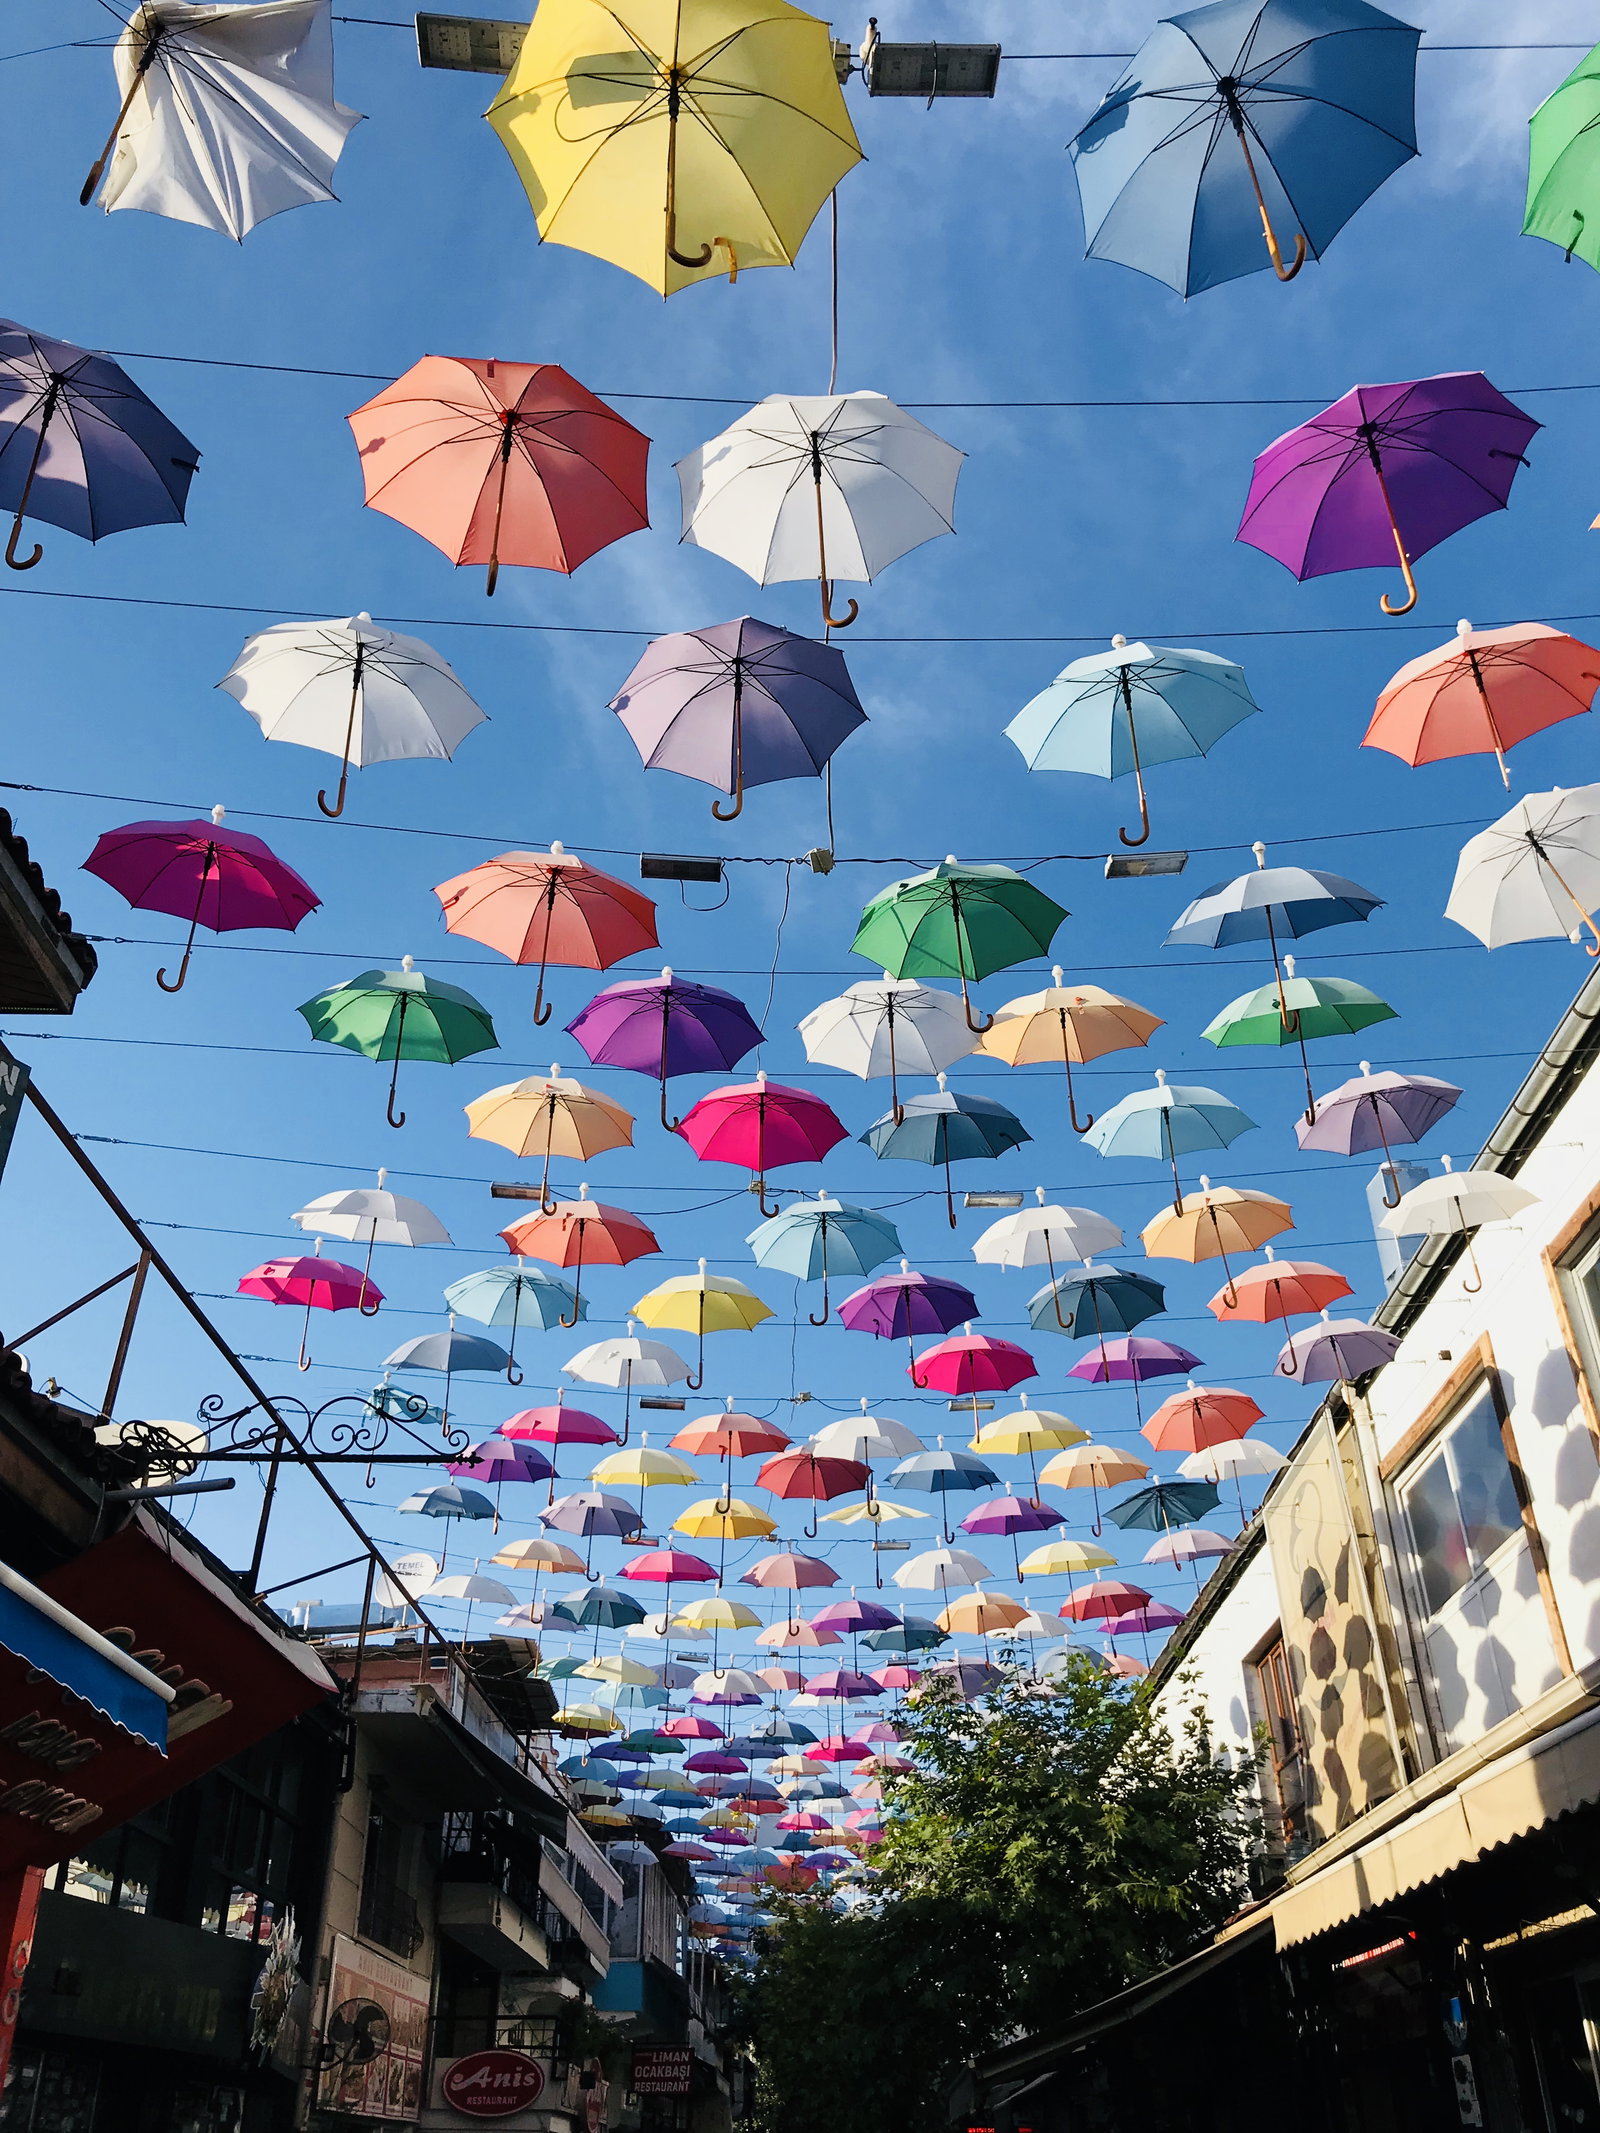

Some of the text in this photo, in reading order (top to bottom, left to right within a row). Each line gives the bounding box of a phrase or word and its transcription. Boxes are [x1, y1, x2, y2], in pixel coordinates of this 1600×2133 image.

[397, 1561, 424, 1569] TEMEL
[450, 2065, 536, 2091] Anis
[634, 2081, 691, 2093] RESTAURANT
[466, 2095, 517, 2105] RESTAURANT
